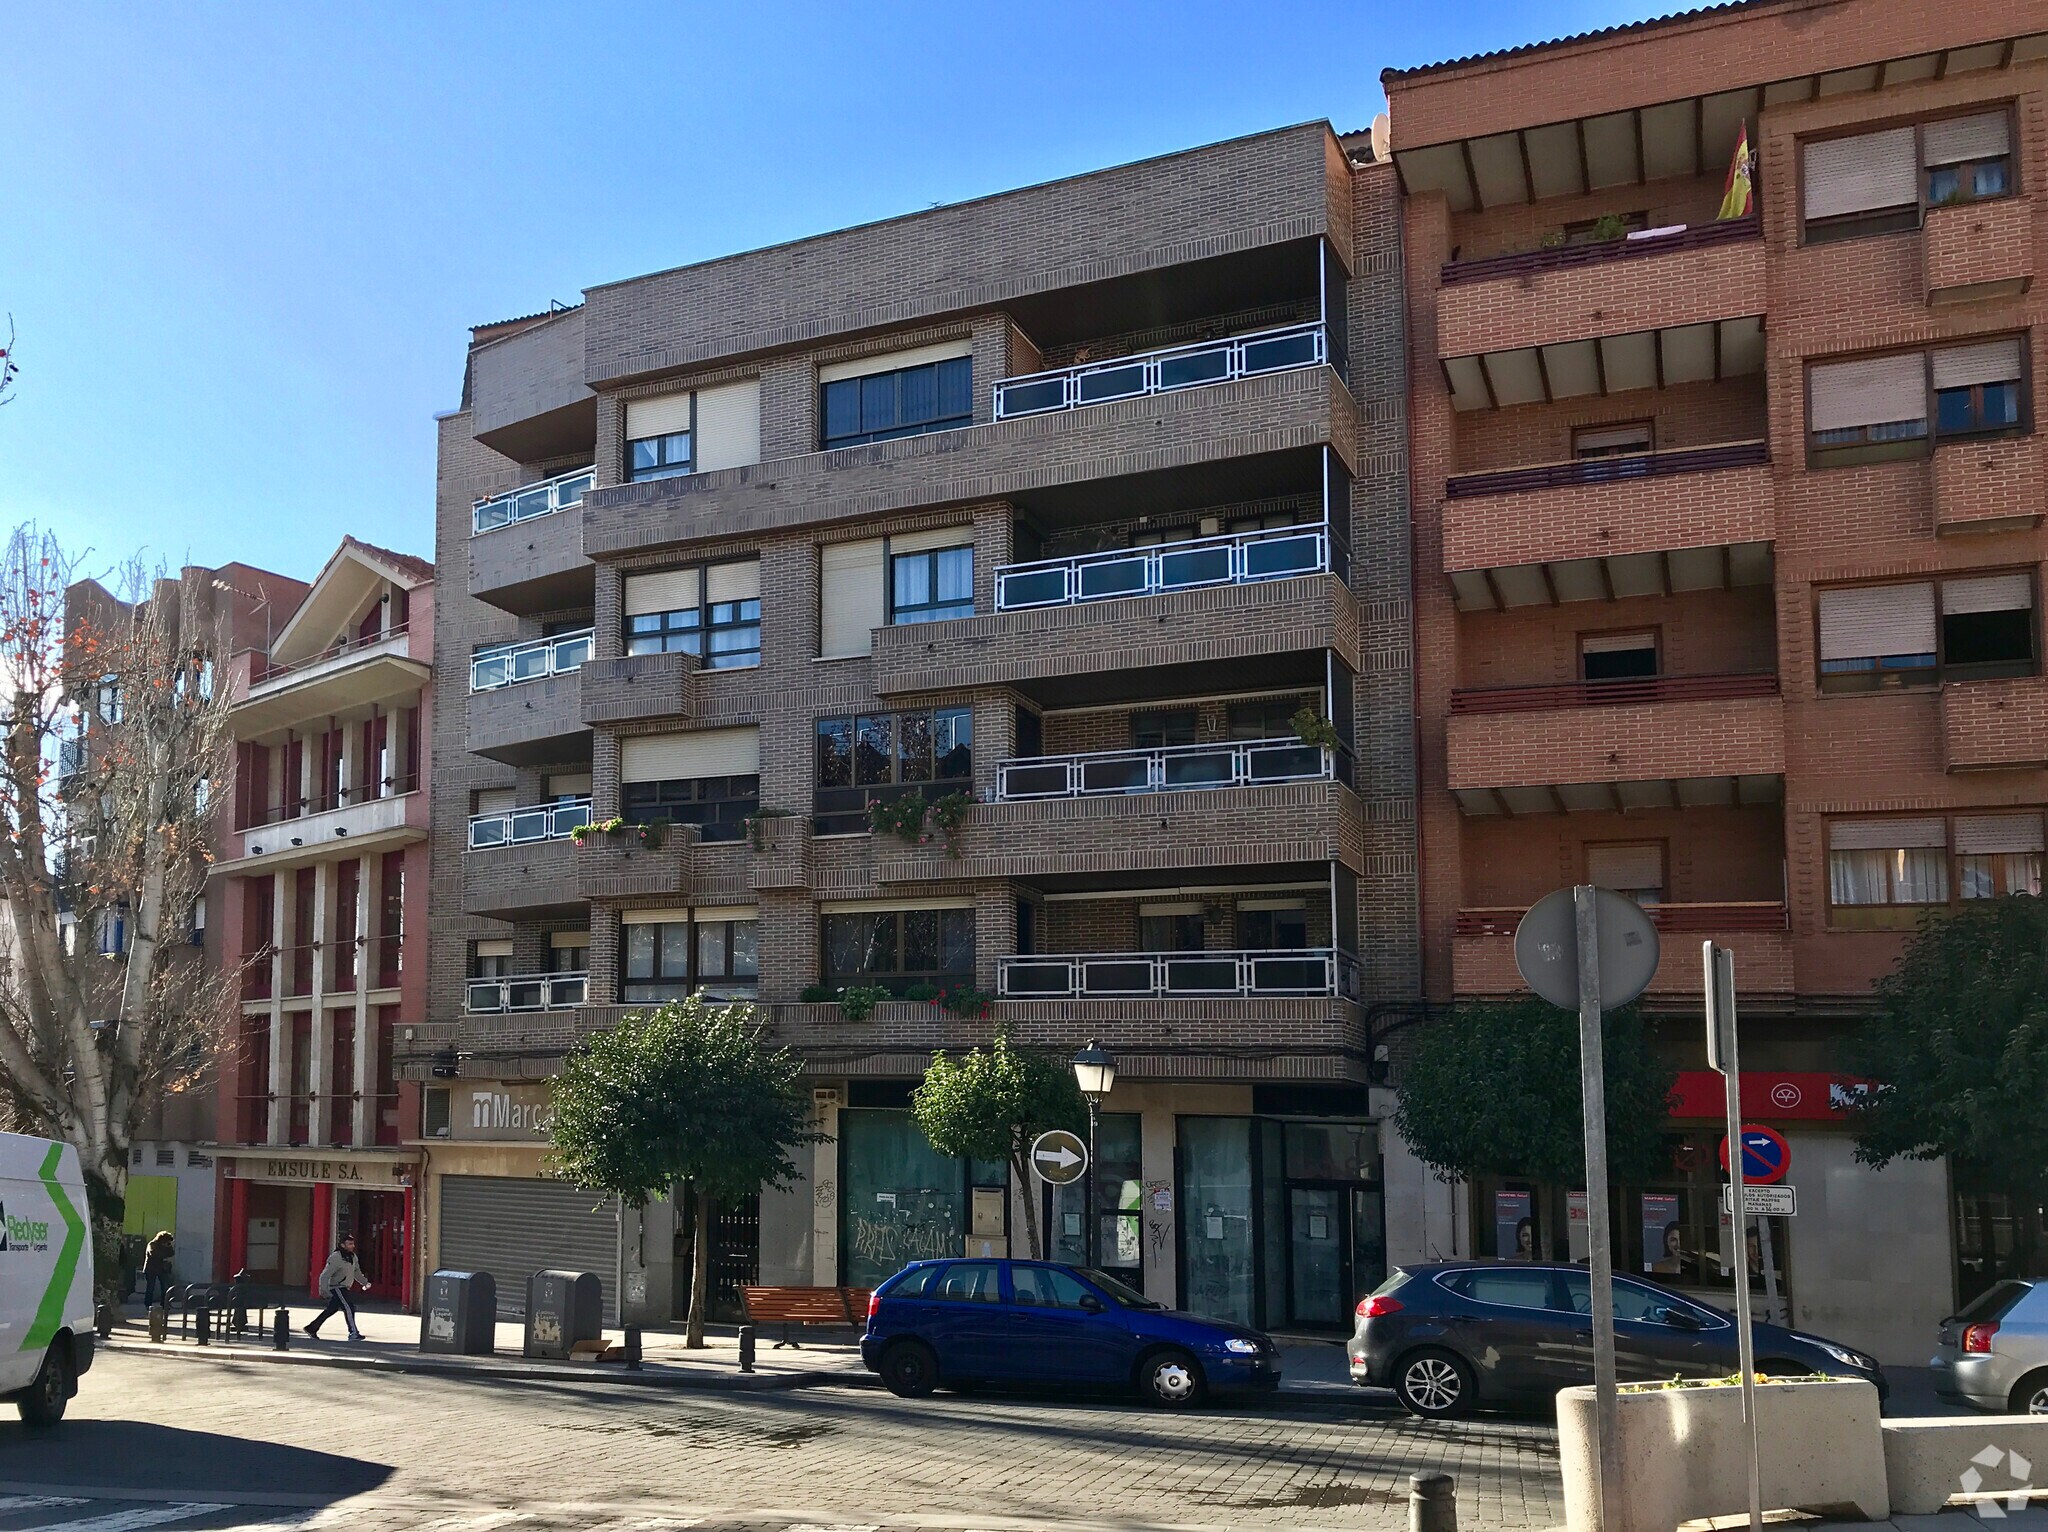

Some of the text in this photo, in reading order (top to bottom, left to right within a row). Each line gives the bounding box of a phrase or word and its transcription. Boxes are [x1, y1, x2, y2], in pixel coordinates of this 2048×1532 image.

[268, 1161, 363, 1180] EMSULE S.A.
[7, 1215, 48, 1247] Redyser
